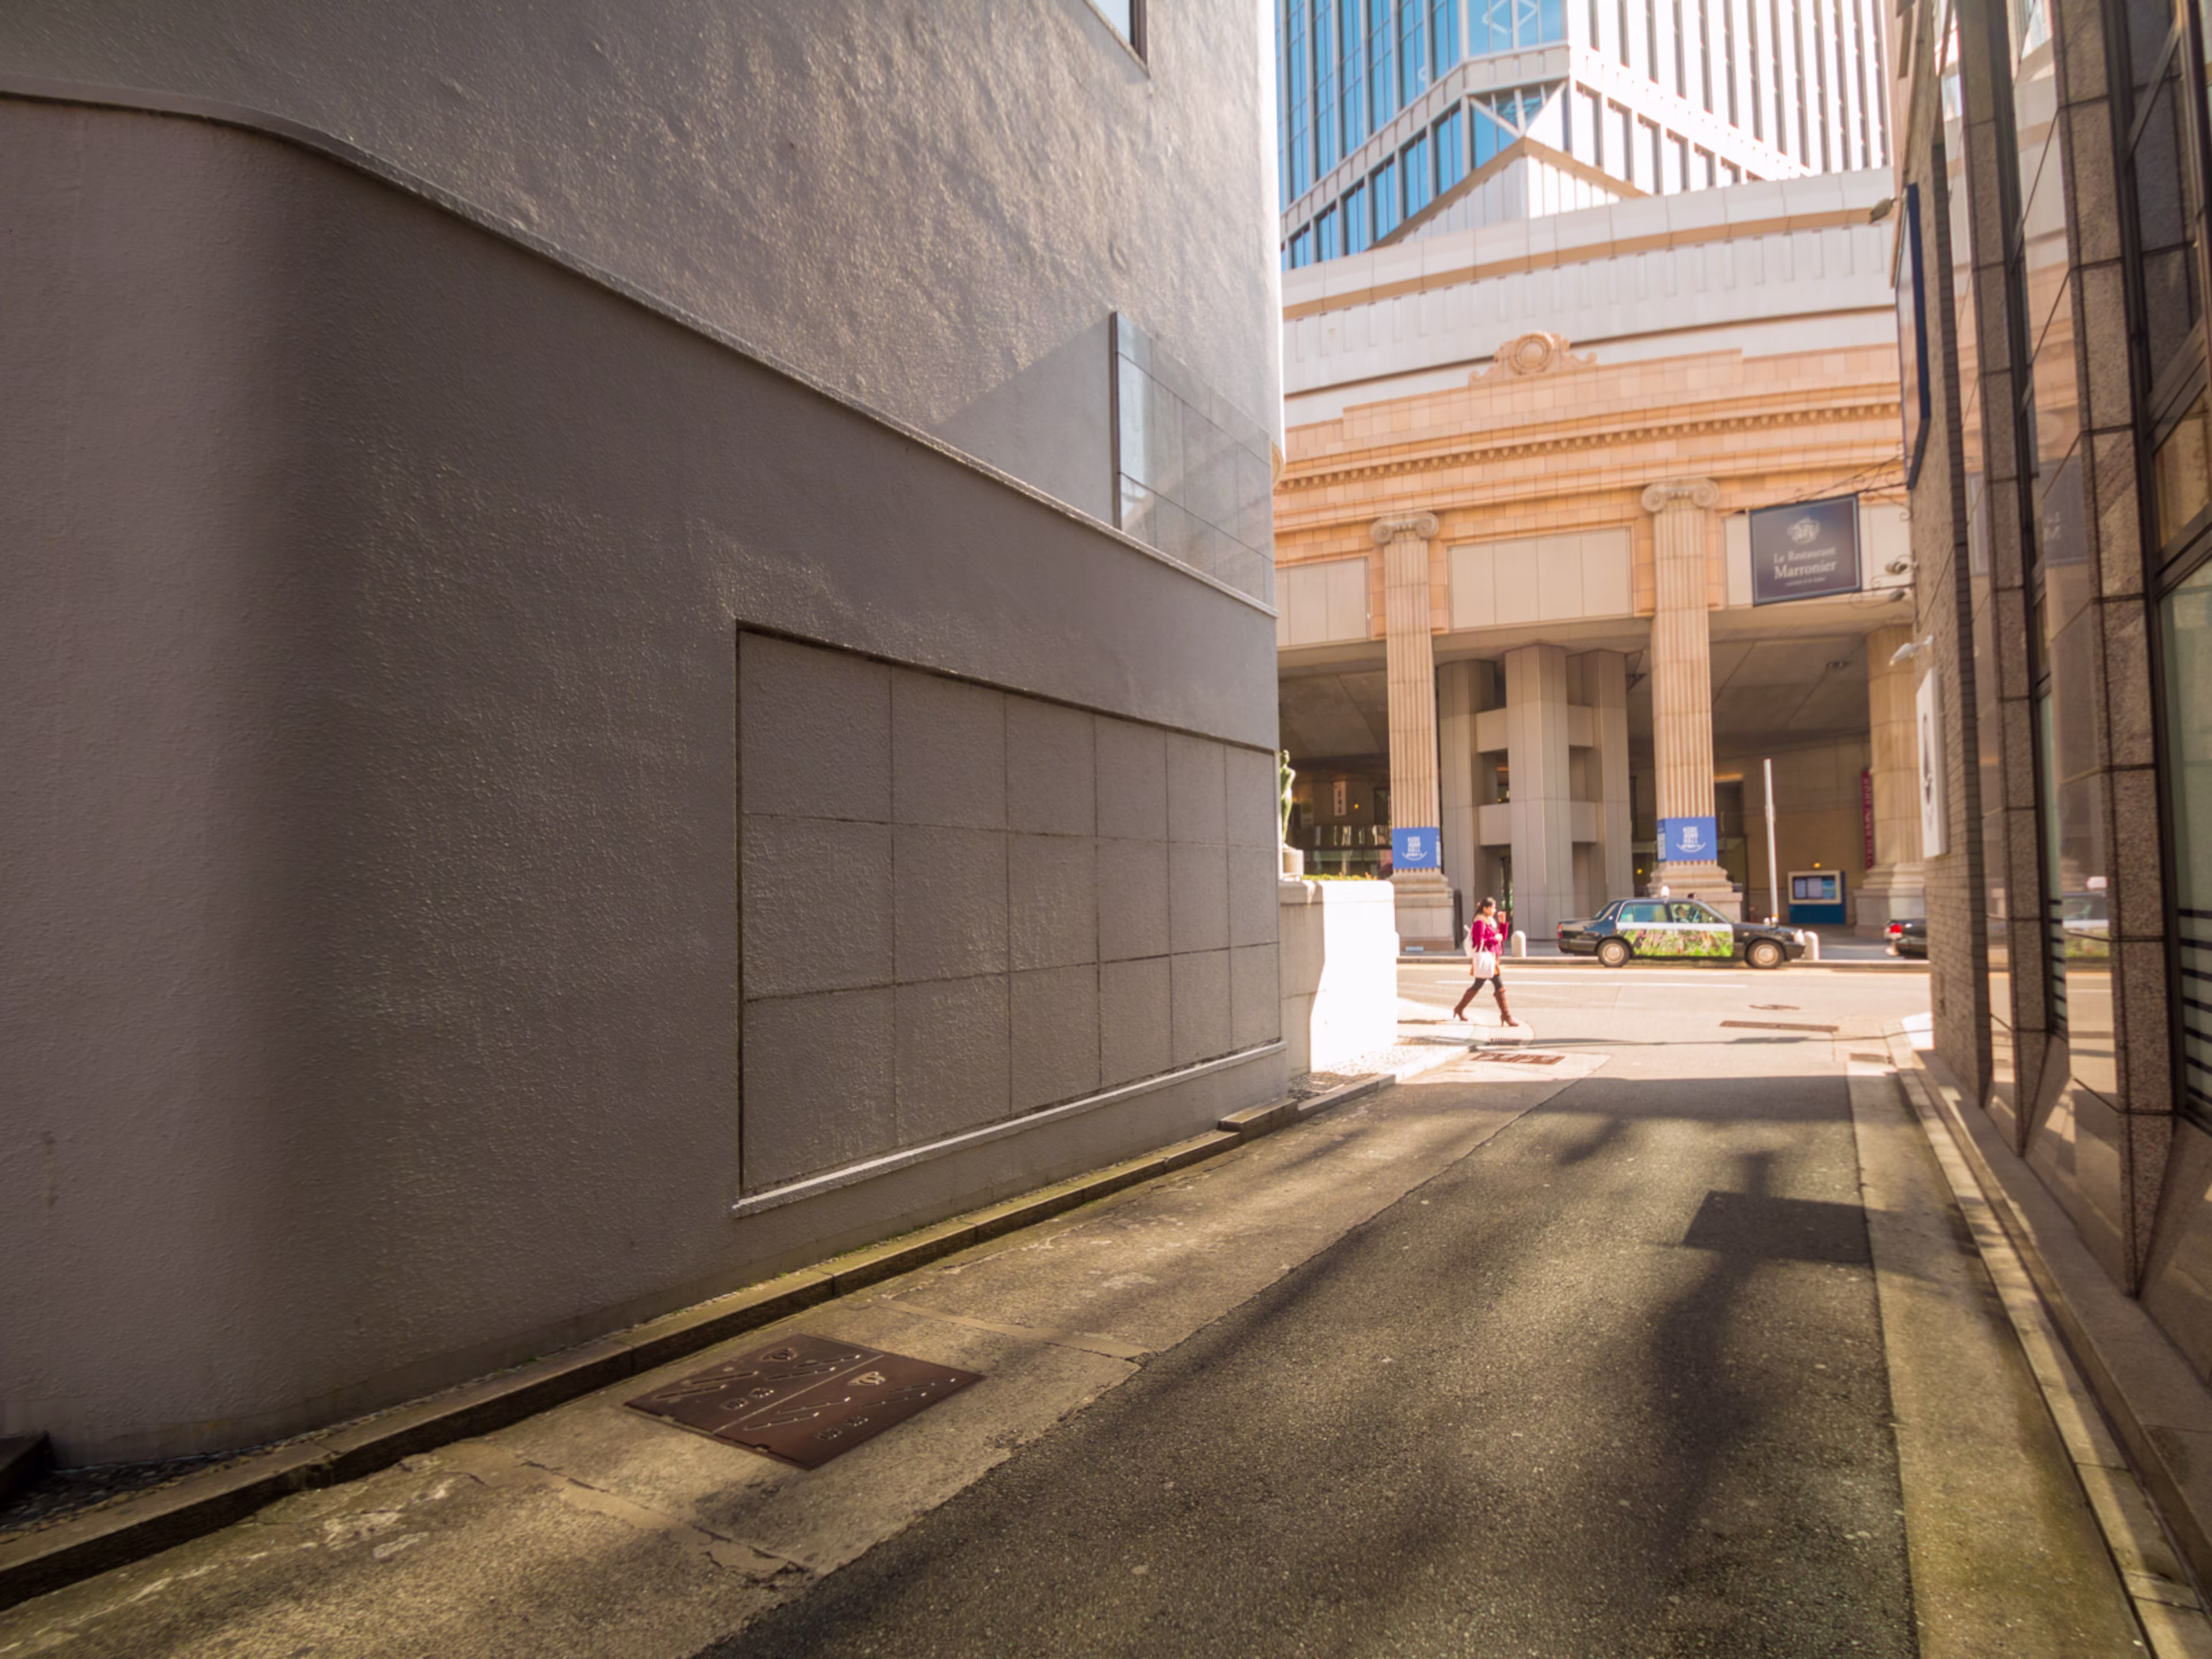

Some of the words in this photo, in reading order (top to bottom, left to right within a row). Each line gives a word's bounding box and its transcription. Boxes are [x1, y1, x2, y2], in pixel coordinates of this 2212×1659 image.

[1774, 553, 1785, 564] Le
[1787, 546, 1836, 561] Restaurant
[1774, 559, 1837, 579] Marronier
